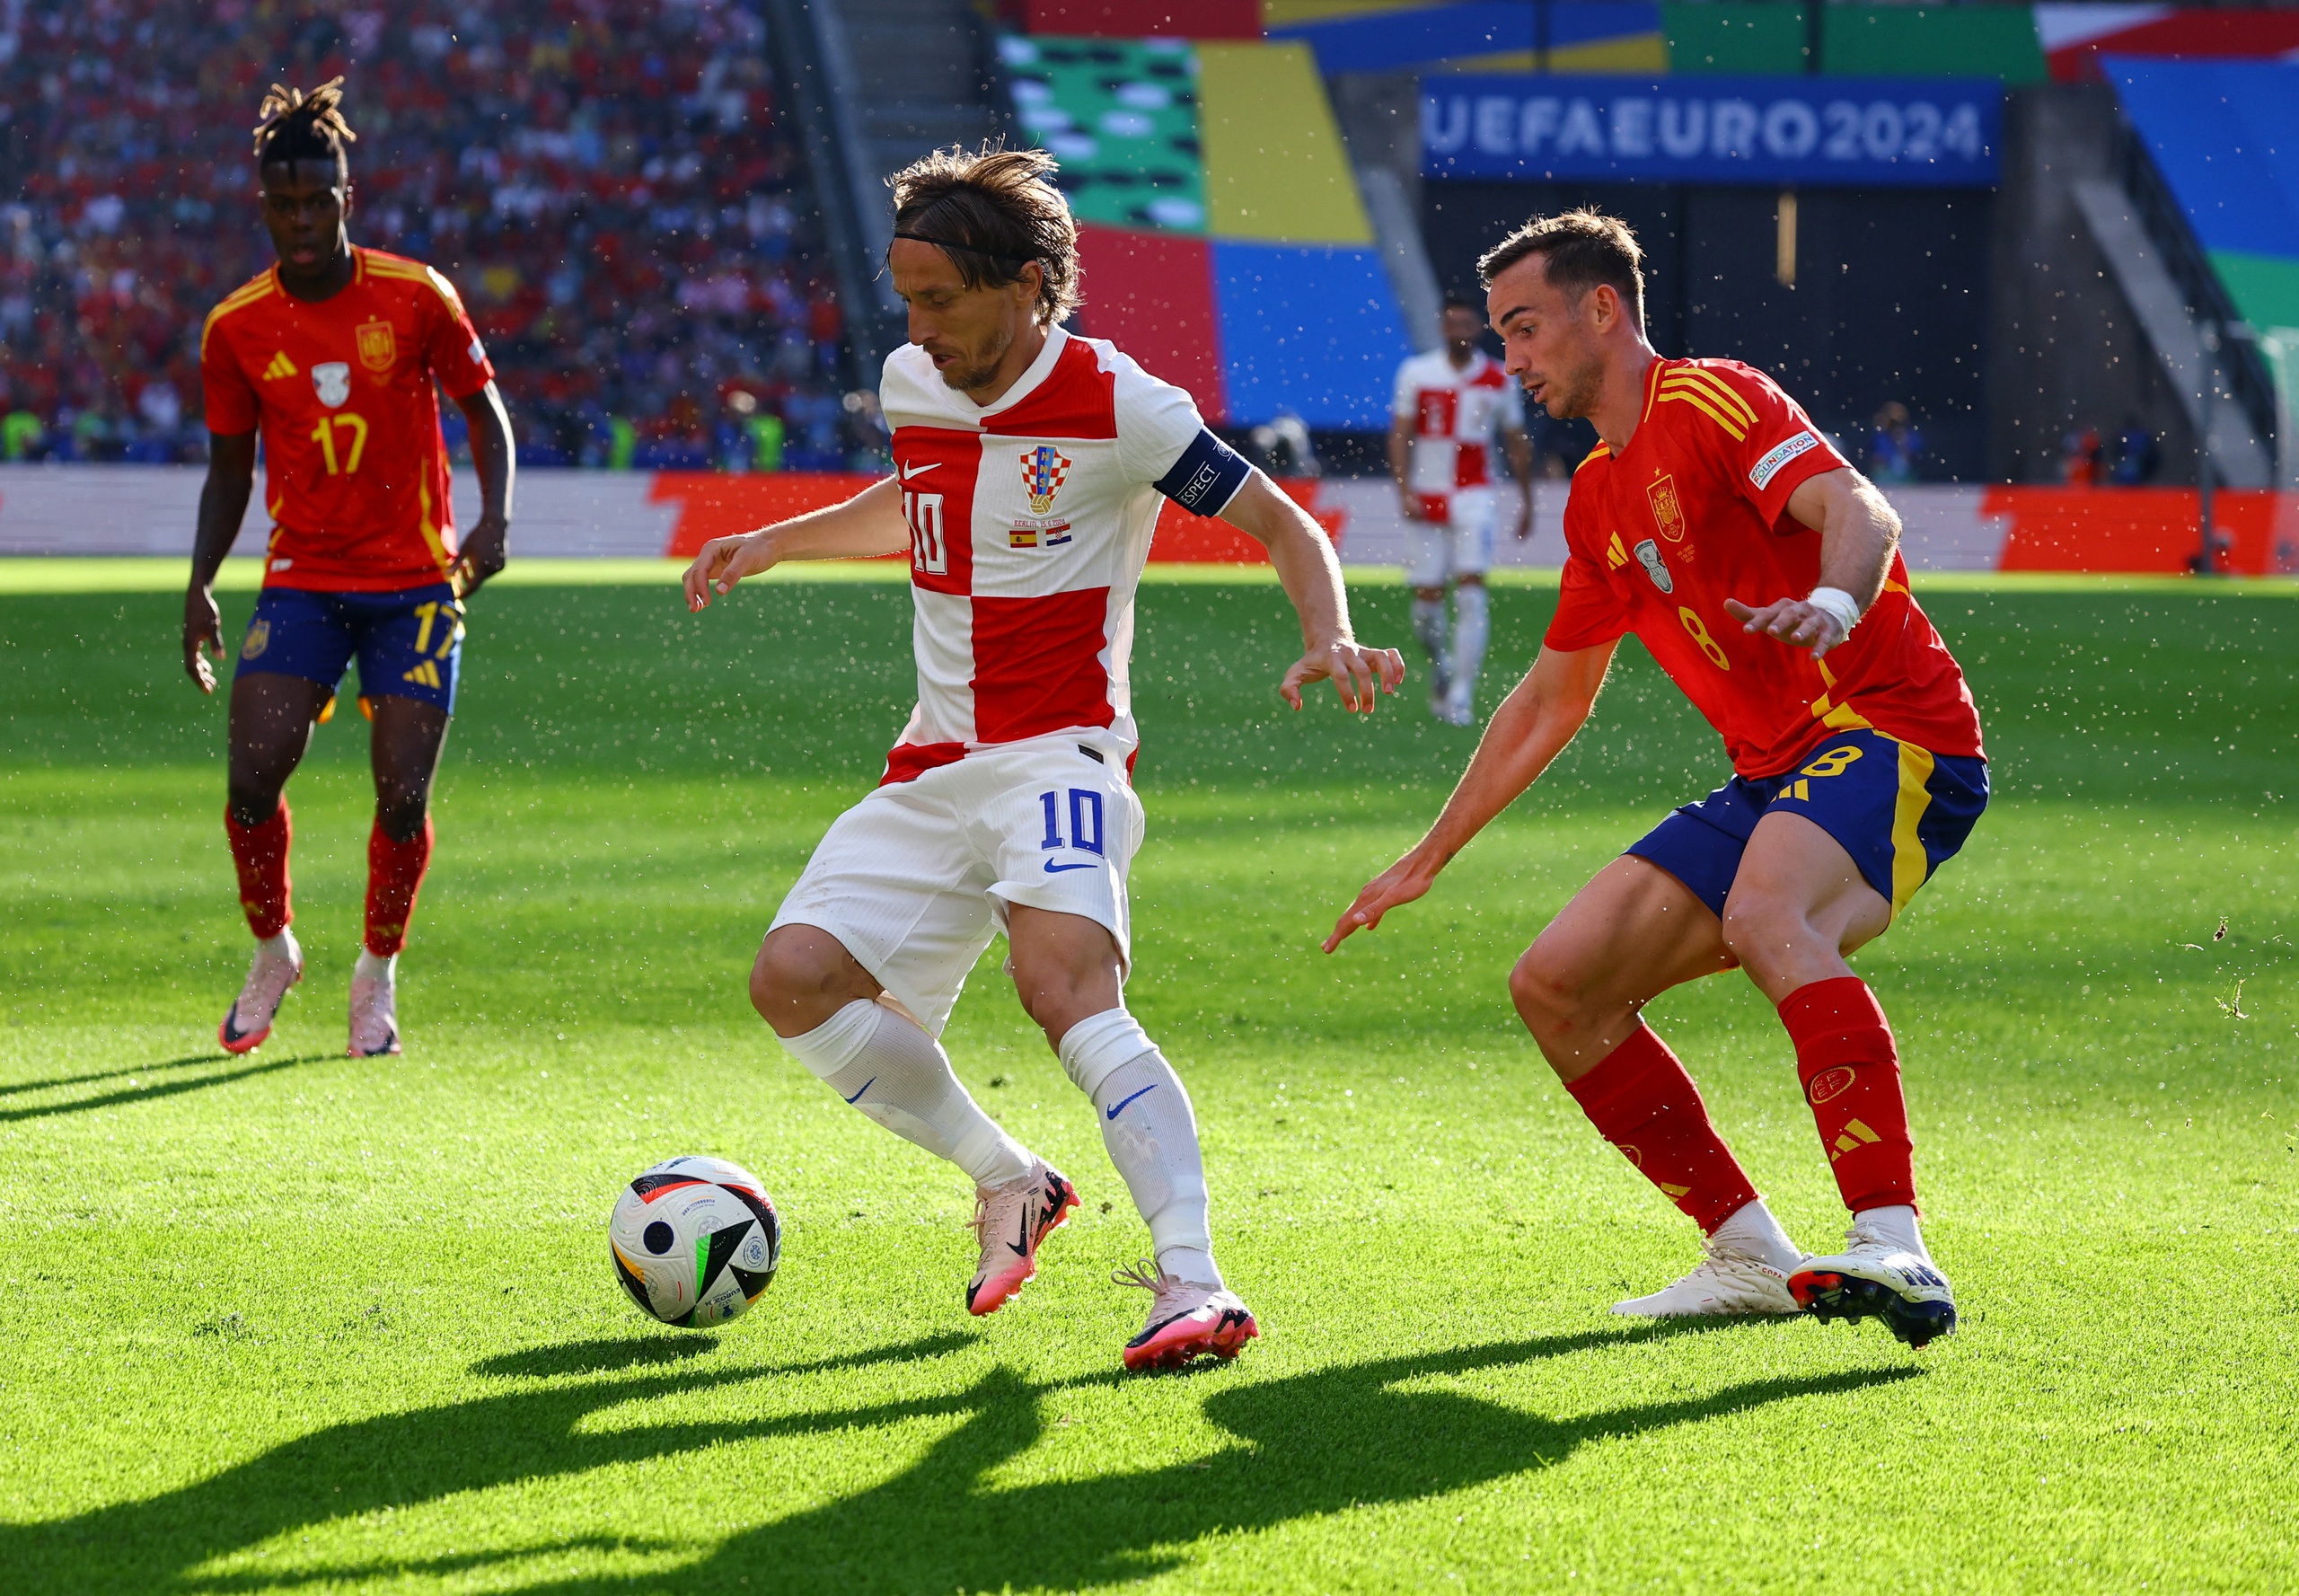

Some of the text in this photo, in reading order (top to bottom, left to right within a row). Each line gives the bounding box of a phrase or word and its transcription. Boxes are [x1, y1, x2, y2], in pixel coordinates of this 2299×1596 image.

[311, 412, 368, 476] 17
[1754, 436, 1813, 484] FOUNDATION
[1179, 464, 1216, 505] ESPECT
[903, 491, 947, 576] 10
[414, 601, 458, 660] 17
[1678, 606, 1730, 670] 8
[1800, 745, 1863, 777] 8
[1039, 788, 1105, 860] 10
[1762, 1267, 1783, 1279] COPA
